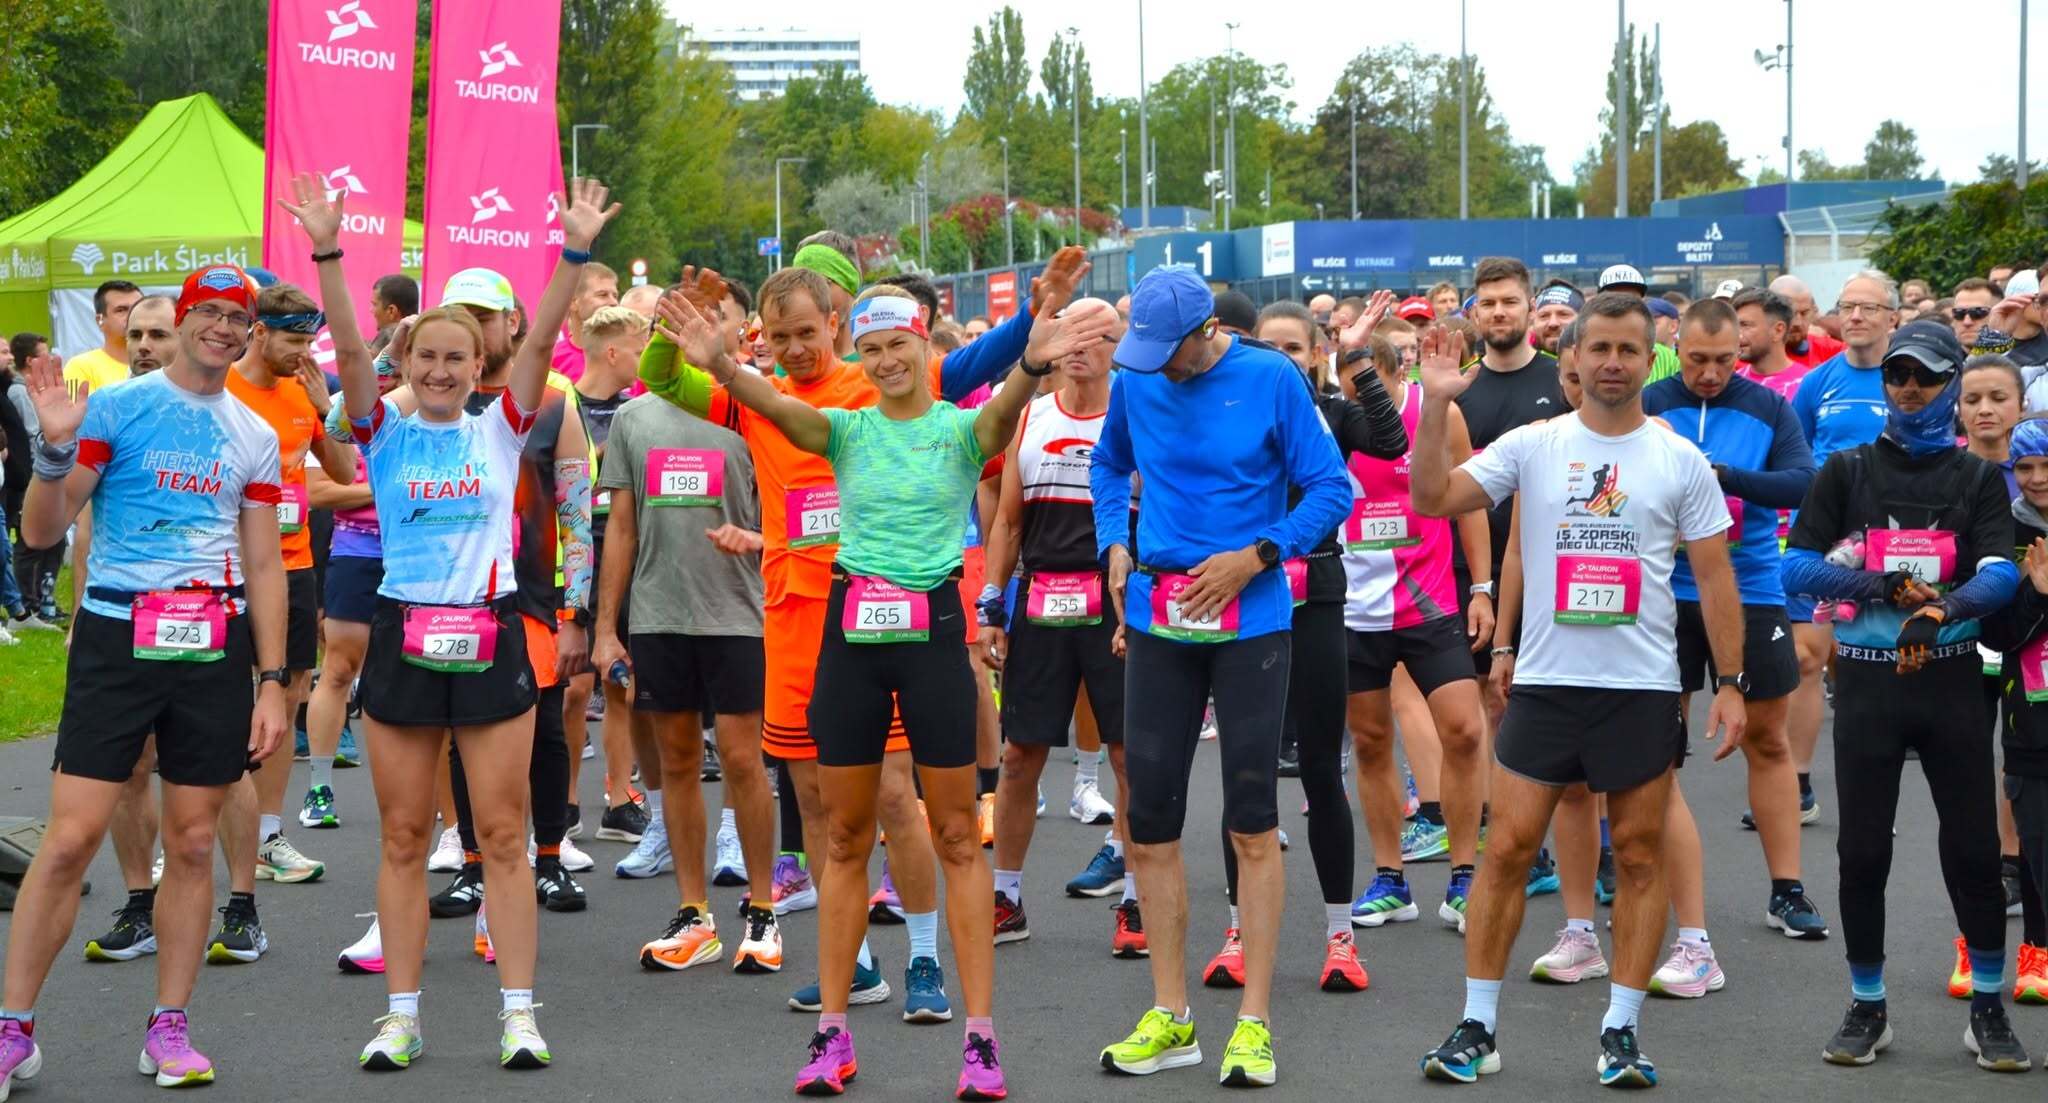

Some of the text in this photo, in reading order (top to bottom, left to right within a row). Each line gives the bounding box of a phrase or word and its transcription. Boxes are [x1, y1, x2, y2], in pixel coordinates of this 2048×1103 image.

[298, 43, 396, 71] TAURON
[455, 80, 539, 105] TAURON
[447, 225, 529, 249] TAURON
[112, 249, 169, 273] Park
[1197, 241, 1213, 276] 1
[1312, 256, 1395, 268] WEJŚCIE ENTRANCE
[1685, 252, 1713, 263] BILETY
[142, 451, 234, 480] HERNIK
[397, 462, 488, 482] HERNIK
[1394, 466, 1410, 475] TAU
[156, 471, 223, 497] TEAM
[408, 478, 482, 500] TEAM
[669, 476, 699, 491] 198
[815, 491, 841, 499] TAURO
[809, 512, 841, 531] 210
[1369, 521, 1399, 537] 123
[1557, 530, 1575, 541] 15.
[1556, 541, 1636, 553] BIEG ULICZNY
[1587, 565, 1618, 573] TAURON
[1898, 561, 1924, 579] 84
[1050, 598, 1078, 613] 255
[1577, 589, 1615, 607] 217
[442, 615, 472, 623] TAURON
[864, 608, 900, 625] 265
[165, 626, 201, 644] 273
[432, 639, 469, 656] 278
